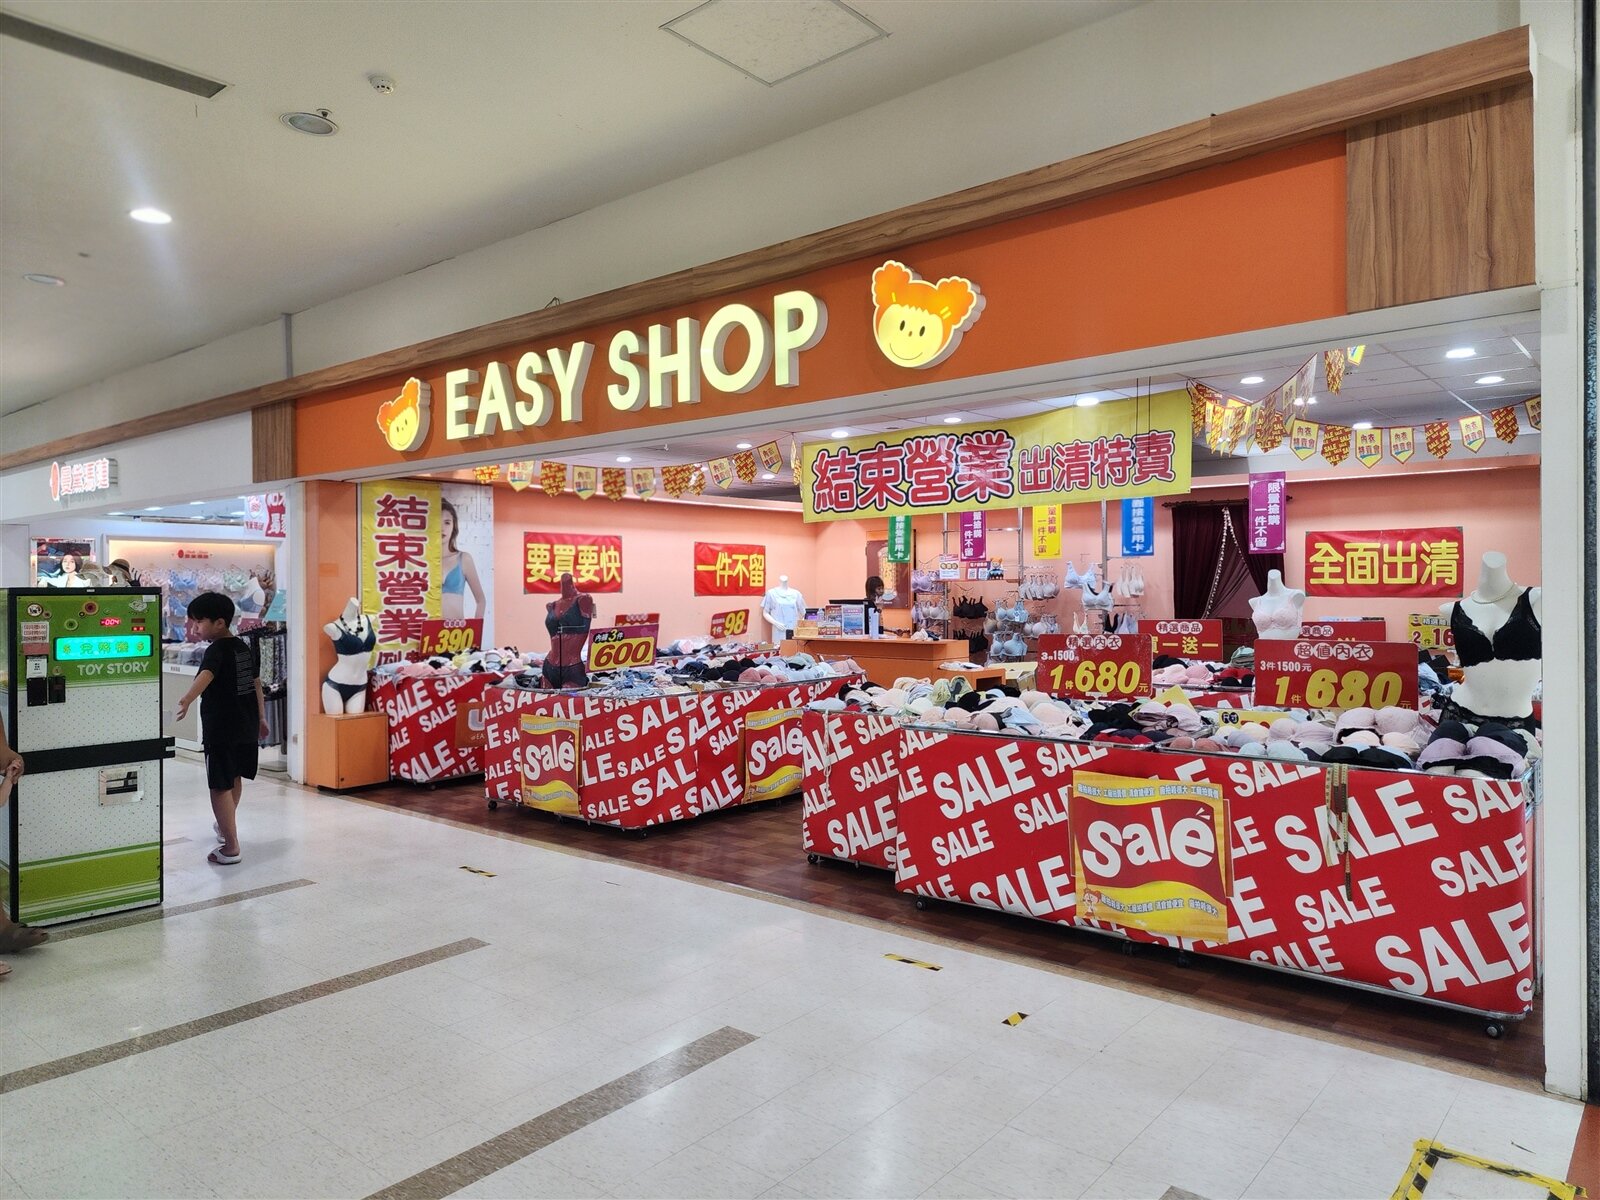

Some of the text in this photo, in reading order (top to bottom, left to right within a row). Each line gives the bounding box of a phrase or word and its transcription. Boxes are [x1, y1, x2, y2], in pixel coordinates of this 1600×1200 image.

[446, 290, 824, 440] EASY SHOP
[813, 429, 1016, 513] 結束營業
[1018, 430, 1176, 494] 出清特賣
[1254, 508, 1267, 547] 一件不留
[374, 494, 429, 644] 結束營業
[526, 542, 621, 583] 要買要快
[696, 551, 765, 588] 一件不留
[1309, 539, 1459, 586] 全面出清
[1295, 643, 1373, 661] 超值內衣
[1302, 626, 1333, 635] 選商品
[77, 661, 149, 676] TOY STORY
[386, 680, 433, 727] SALE
[419, 699, 457, 733] SALE
[617, 744, 666, 777] SALE
[850, 750, 899, 793] SALE
[933, 742, 1036, 820] SALE
[587, 794, 631, 819] SALE
[827, 794, 897, 860] SALE
[1275, 780, 1439, 874] SALE
[931, 819, 995, 867] SALE
[1430, 833, 1528, 897] SALE
[1295, 877, 1395, 933] SALE
[1375, 902, 1532, 996] SALE
